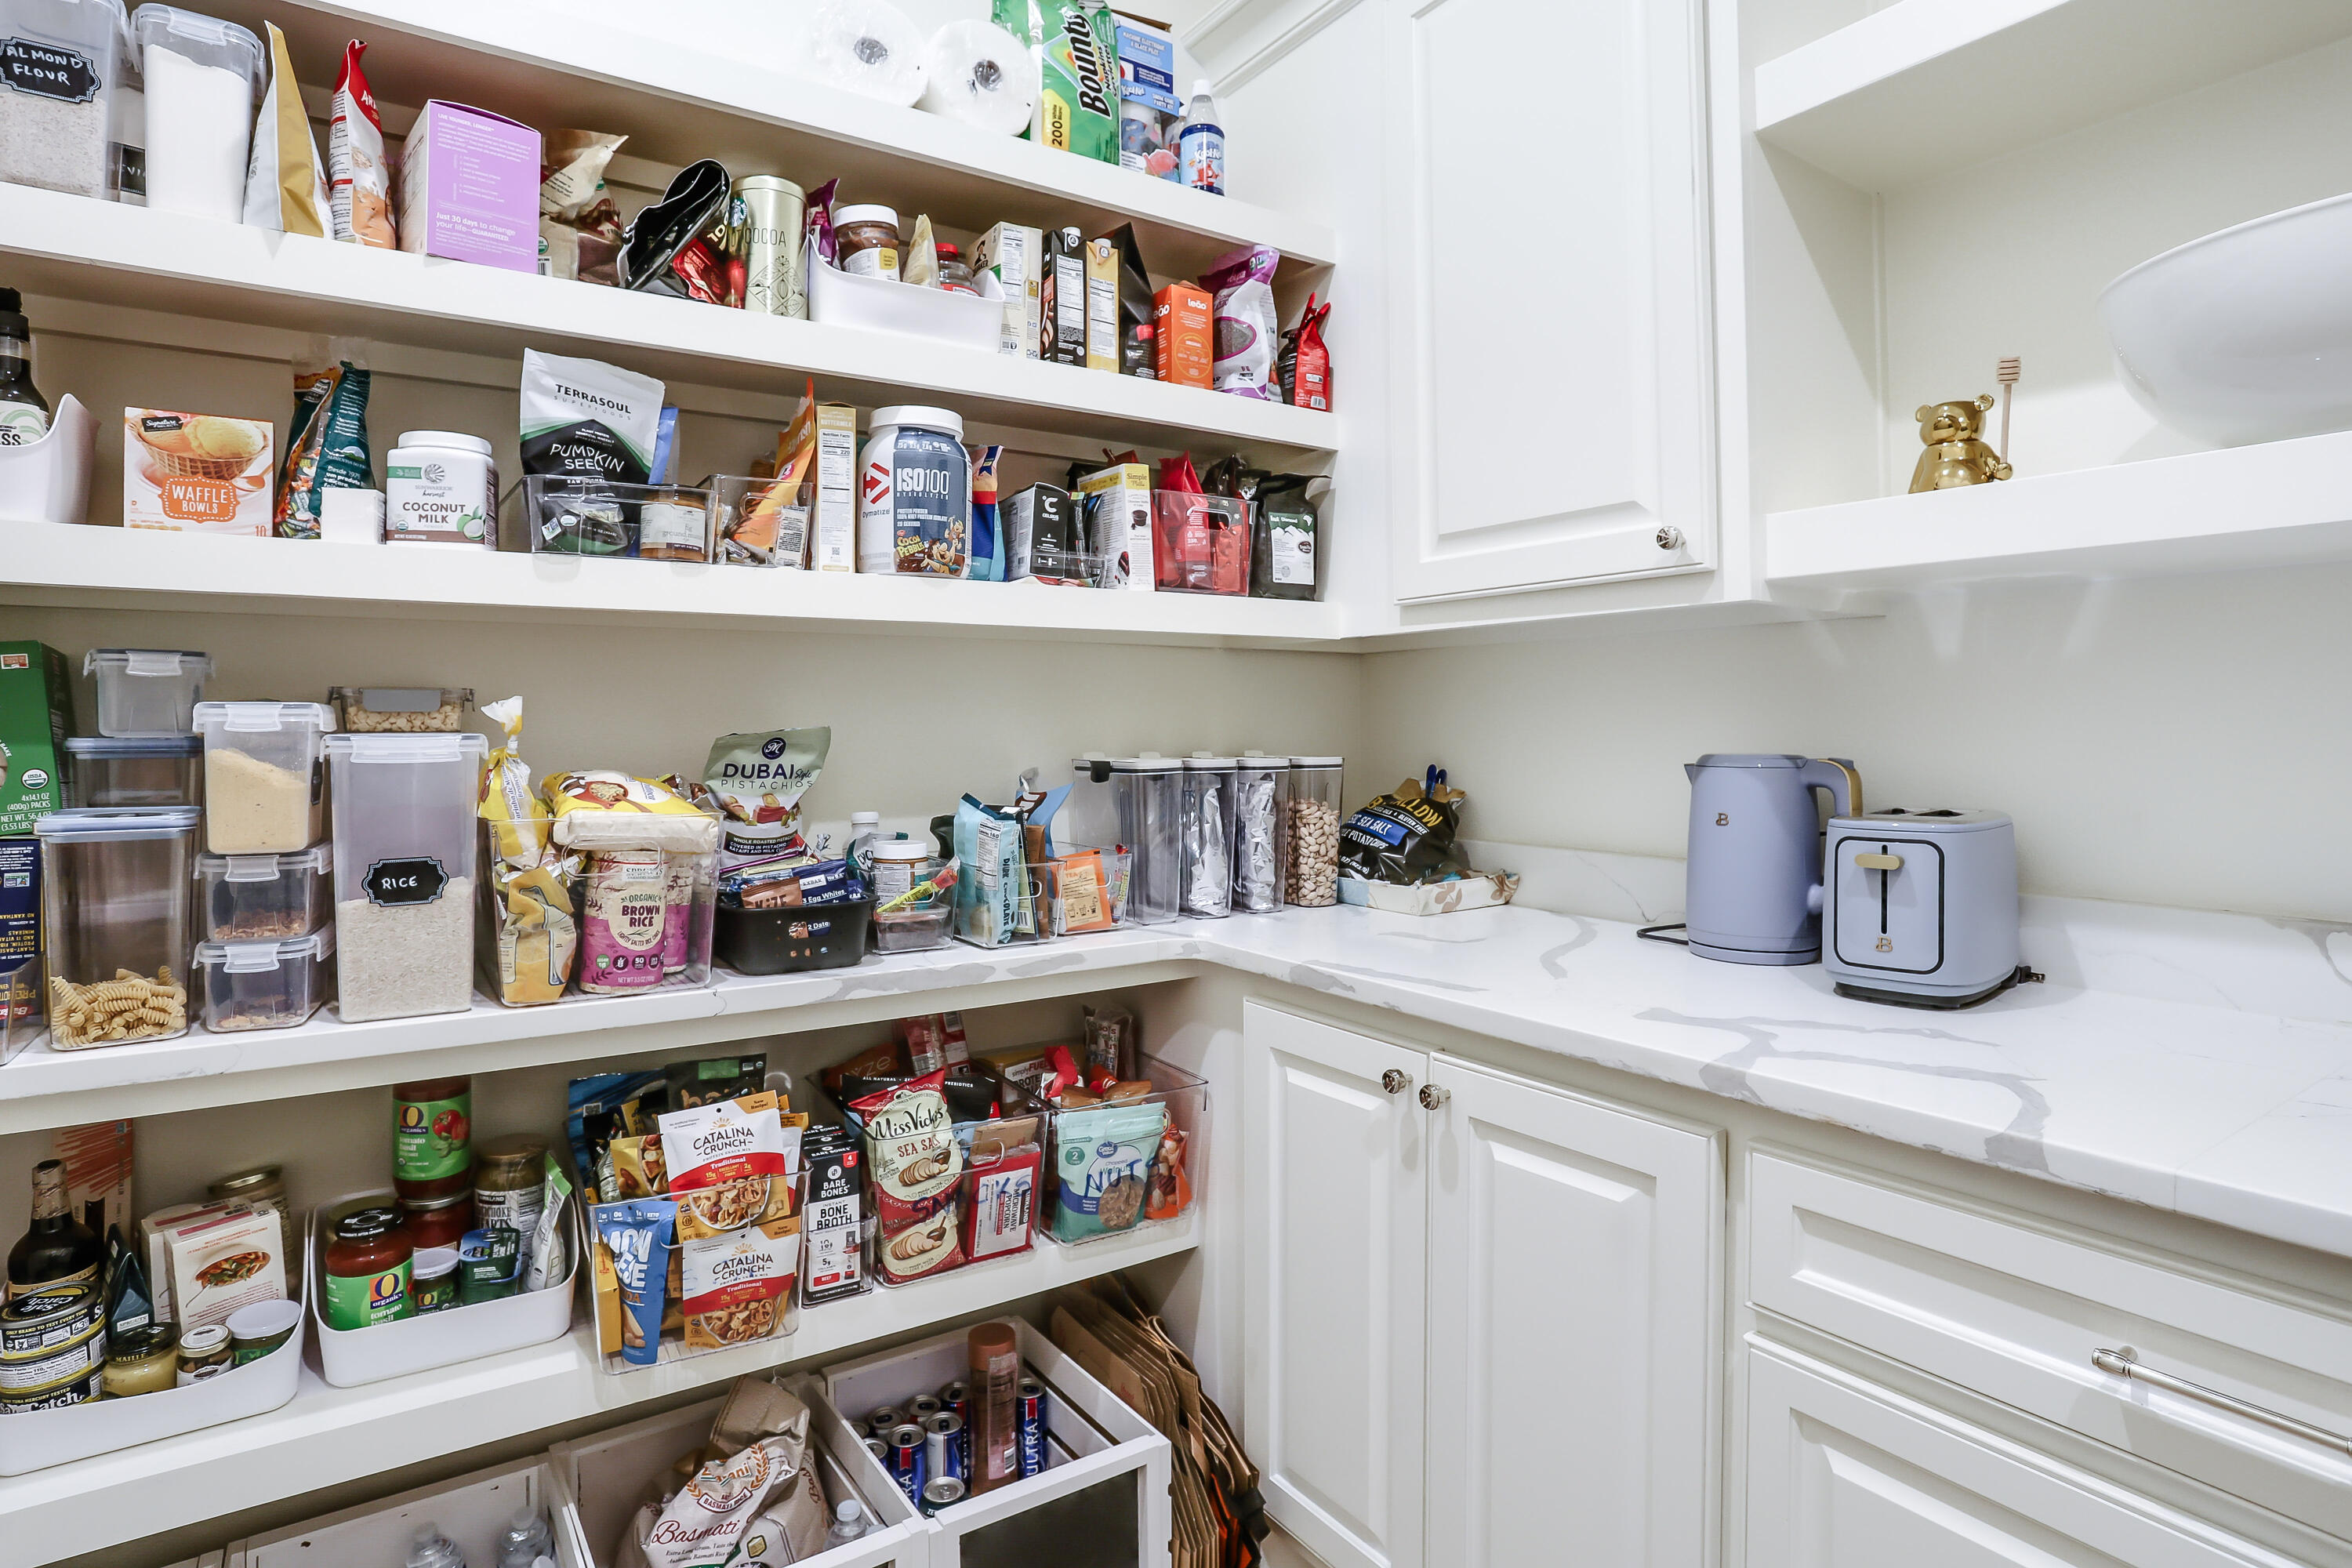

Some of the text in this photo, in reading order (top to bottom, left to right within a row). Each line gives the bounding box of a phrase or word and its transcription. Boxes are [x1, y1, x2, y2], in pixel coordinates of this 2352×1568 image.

[6, 45, 84, 68] ALMOND
[1062, 12, 1112, 120] Bounty
[13, 63, 71, 85] FLOUR
[1051, 121, 1063, 147] 200
[488, 225, 516, 236] change
[745, 227, 786, 247] COCOA
[555, 383, 632, 414] TERRASOUL
[172, 484, 228, 504] WAFFLE
[182, 501, 219, 514] BOWLS
[402, 502, 466, 514] COCONUT
[862, 509, 890, 518] Dymatize
[418, 514, 450, 524] MILK
[897, 535, 921, 546] COCOA
[722, 762, 794, 780] DUBAI
[720, 779, 814, 790] PISTACHIOS
[1358, 816, 1374, 828] SEA
[1370, 820, 1392, 836] SALT
[730, 841, 755, 850] COVERED
[733, 836, 752, 844] WHOLE
[381, 875, 418, 890] RICE
[628, 894, 658, 902] ORGANIC
[808, 895, 822, 903] Egg
[822, 889, 846, 899] Whites
[622, 905, 660, 916] BROWN
[629, 916, 654, 927] RICE
[875, 1117, 911, 1139] Miss
[693, 1127, 754, 1150] CATALINA
[897, 1142, 918, 1157] SEA
[710, 1156, 746, 1170] Traditional
[1101, 1165, 1131, 1174] Walnuts
[823, 1178, 846, 1189] BARE
[821, 1185, 851, 1198] BONES
[820, 1203, 848, 1219] BONE
[1004, 1193, 1012, 1229] POPCORN
[1010, 1189, 1019, 1232] MICROWAVE
[817, 1214, 852, 1229] BROTH
[712, 1254, 774, 1275] CATALINA
[727, 1280, 762, 1293] Traditional
[372, 1293, 403, 1308] organics
[370, 1304, 403, 1320] tomato
[59, 1315, 76, 1324] EVERY
[115, 1353, 147, 1363] MAILLE
[51, 1387, 71, 1396] TESTED
[1025, 1421, 1038, 1475] ULTRA
[703, 1498, 733, 1510] BASMATI
[652, 1519, 740, 1544] Basmati
